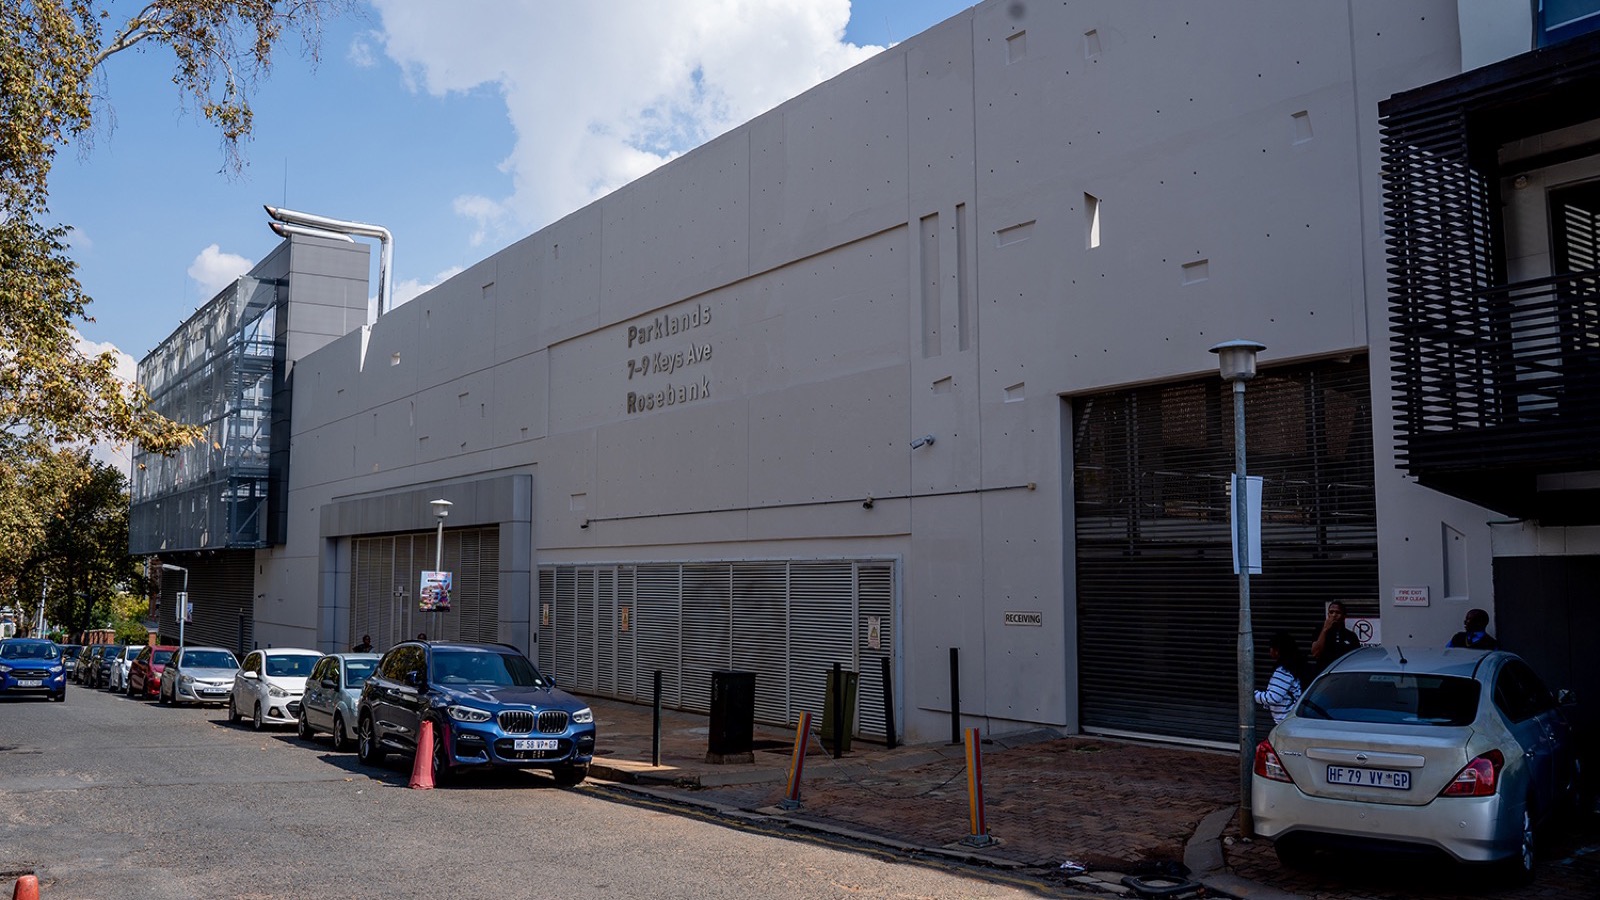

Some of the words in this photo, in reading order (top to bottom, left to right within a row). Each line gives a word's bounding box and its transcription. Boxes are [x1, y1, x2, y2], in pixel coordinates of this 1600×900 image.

[627, 304, 711, 348] Parklands
[627, 356, 650, 380] 7-9
[653, 352, 684, 374] Keys
[686, 343, 712, 366] Ave
[627, 375, 710, 414] Rosebank
[1005, 613, 1040, 623] RECEIVING
[1329, 768, 1343, 781] HF
[1348, 770, 1362, 783] 79
[1369, 771, 1383, 784] VY
[1393, 773, 1408, 787] GP
